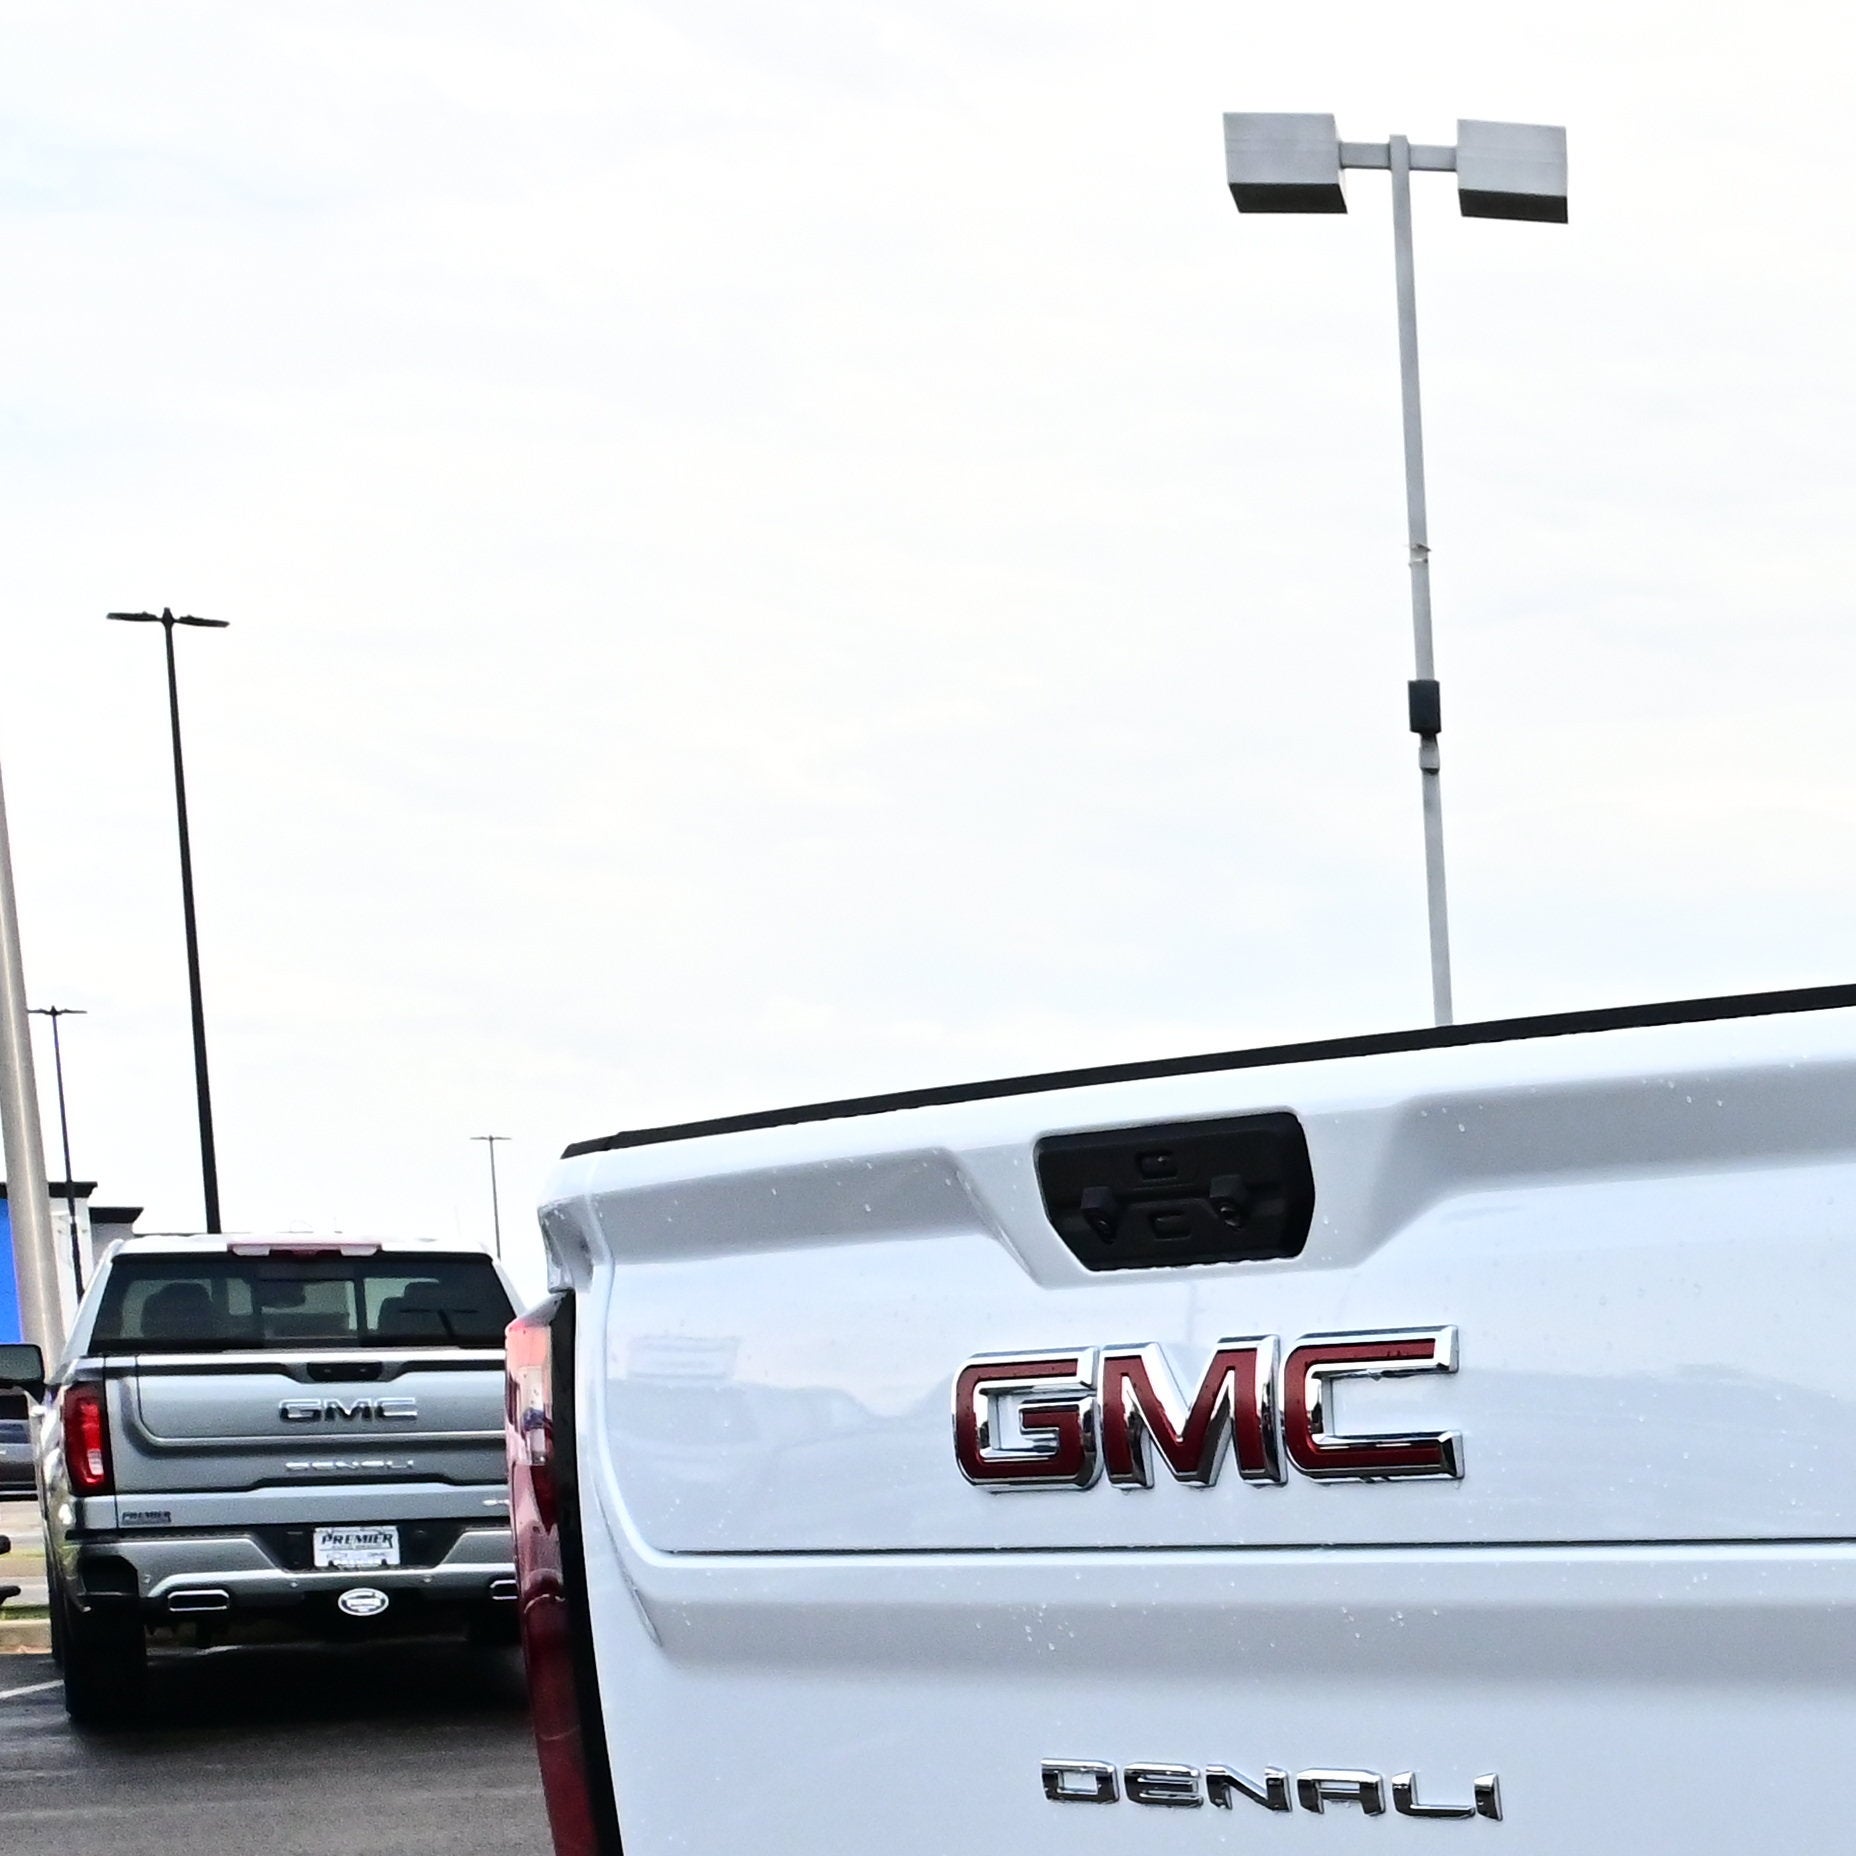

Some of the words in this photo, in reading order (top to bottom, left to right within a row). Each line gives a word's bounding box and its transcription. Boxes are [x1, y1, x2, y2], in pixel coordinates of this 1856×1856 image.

[279, 1397, 418, 1422] GMC
[952, 1324, 1465, 1494] GMC
[321, 1532, 393, 1548] PREMIER
[1040, 1757, 1503, 1822] DENALI
